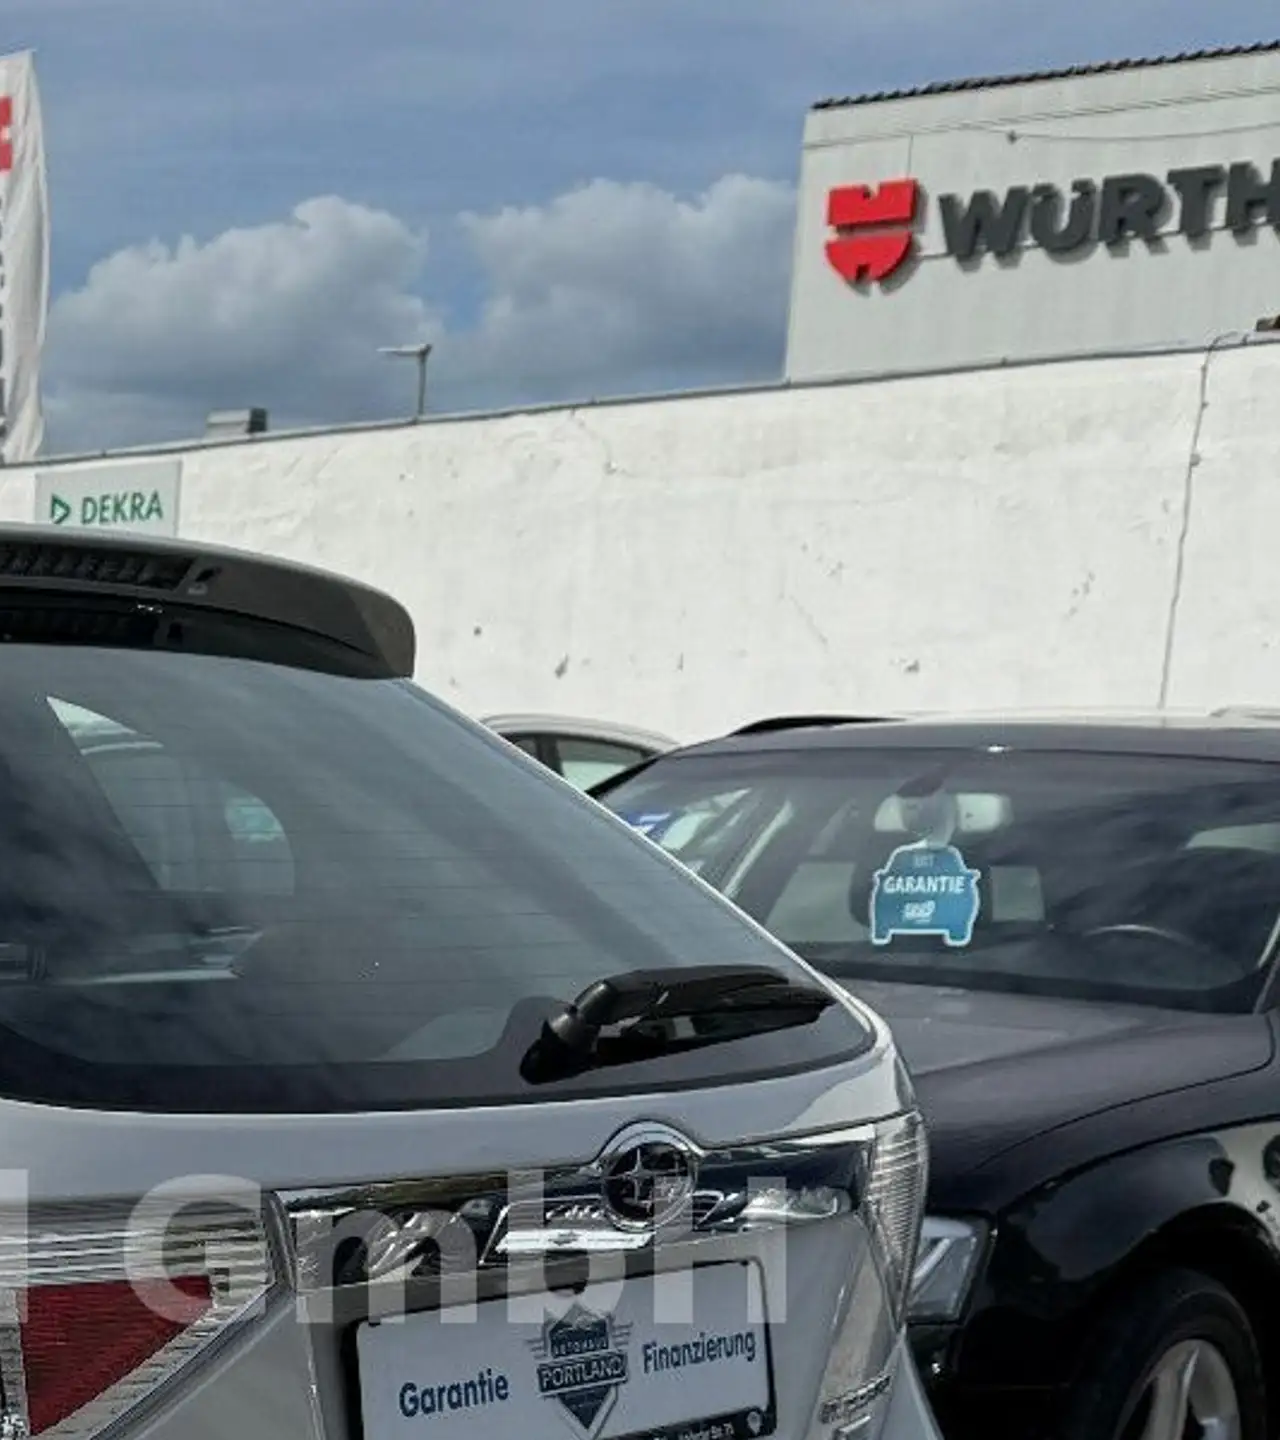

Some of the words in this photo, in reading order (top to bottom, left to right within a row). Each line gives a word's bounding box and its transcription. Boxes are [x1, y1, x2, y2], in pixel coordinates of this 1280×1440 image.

[81, 490, 163, 525] DEKRA
[883, 875, 965, 894] GARANTIE
[643, 1330, 756, 1374] Finanzierung
[541, 1356, 622, 1389] PORTLAND
[399, 1367, 509, 1417] Garantie
